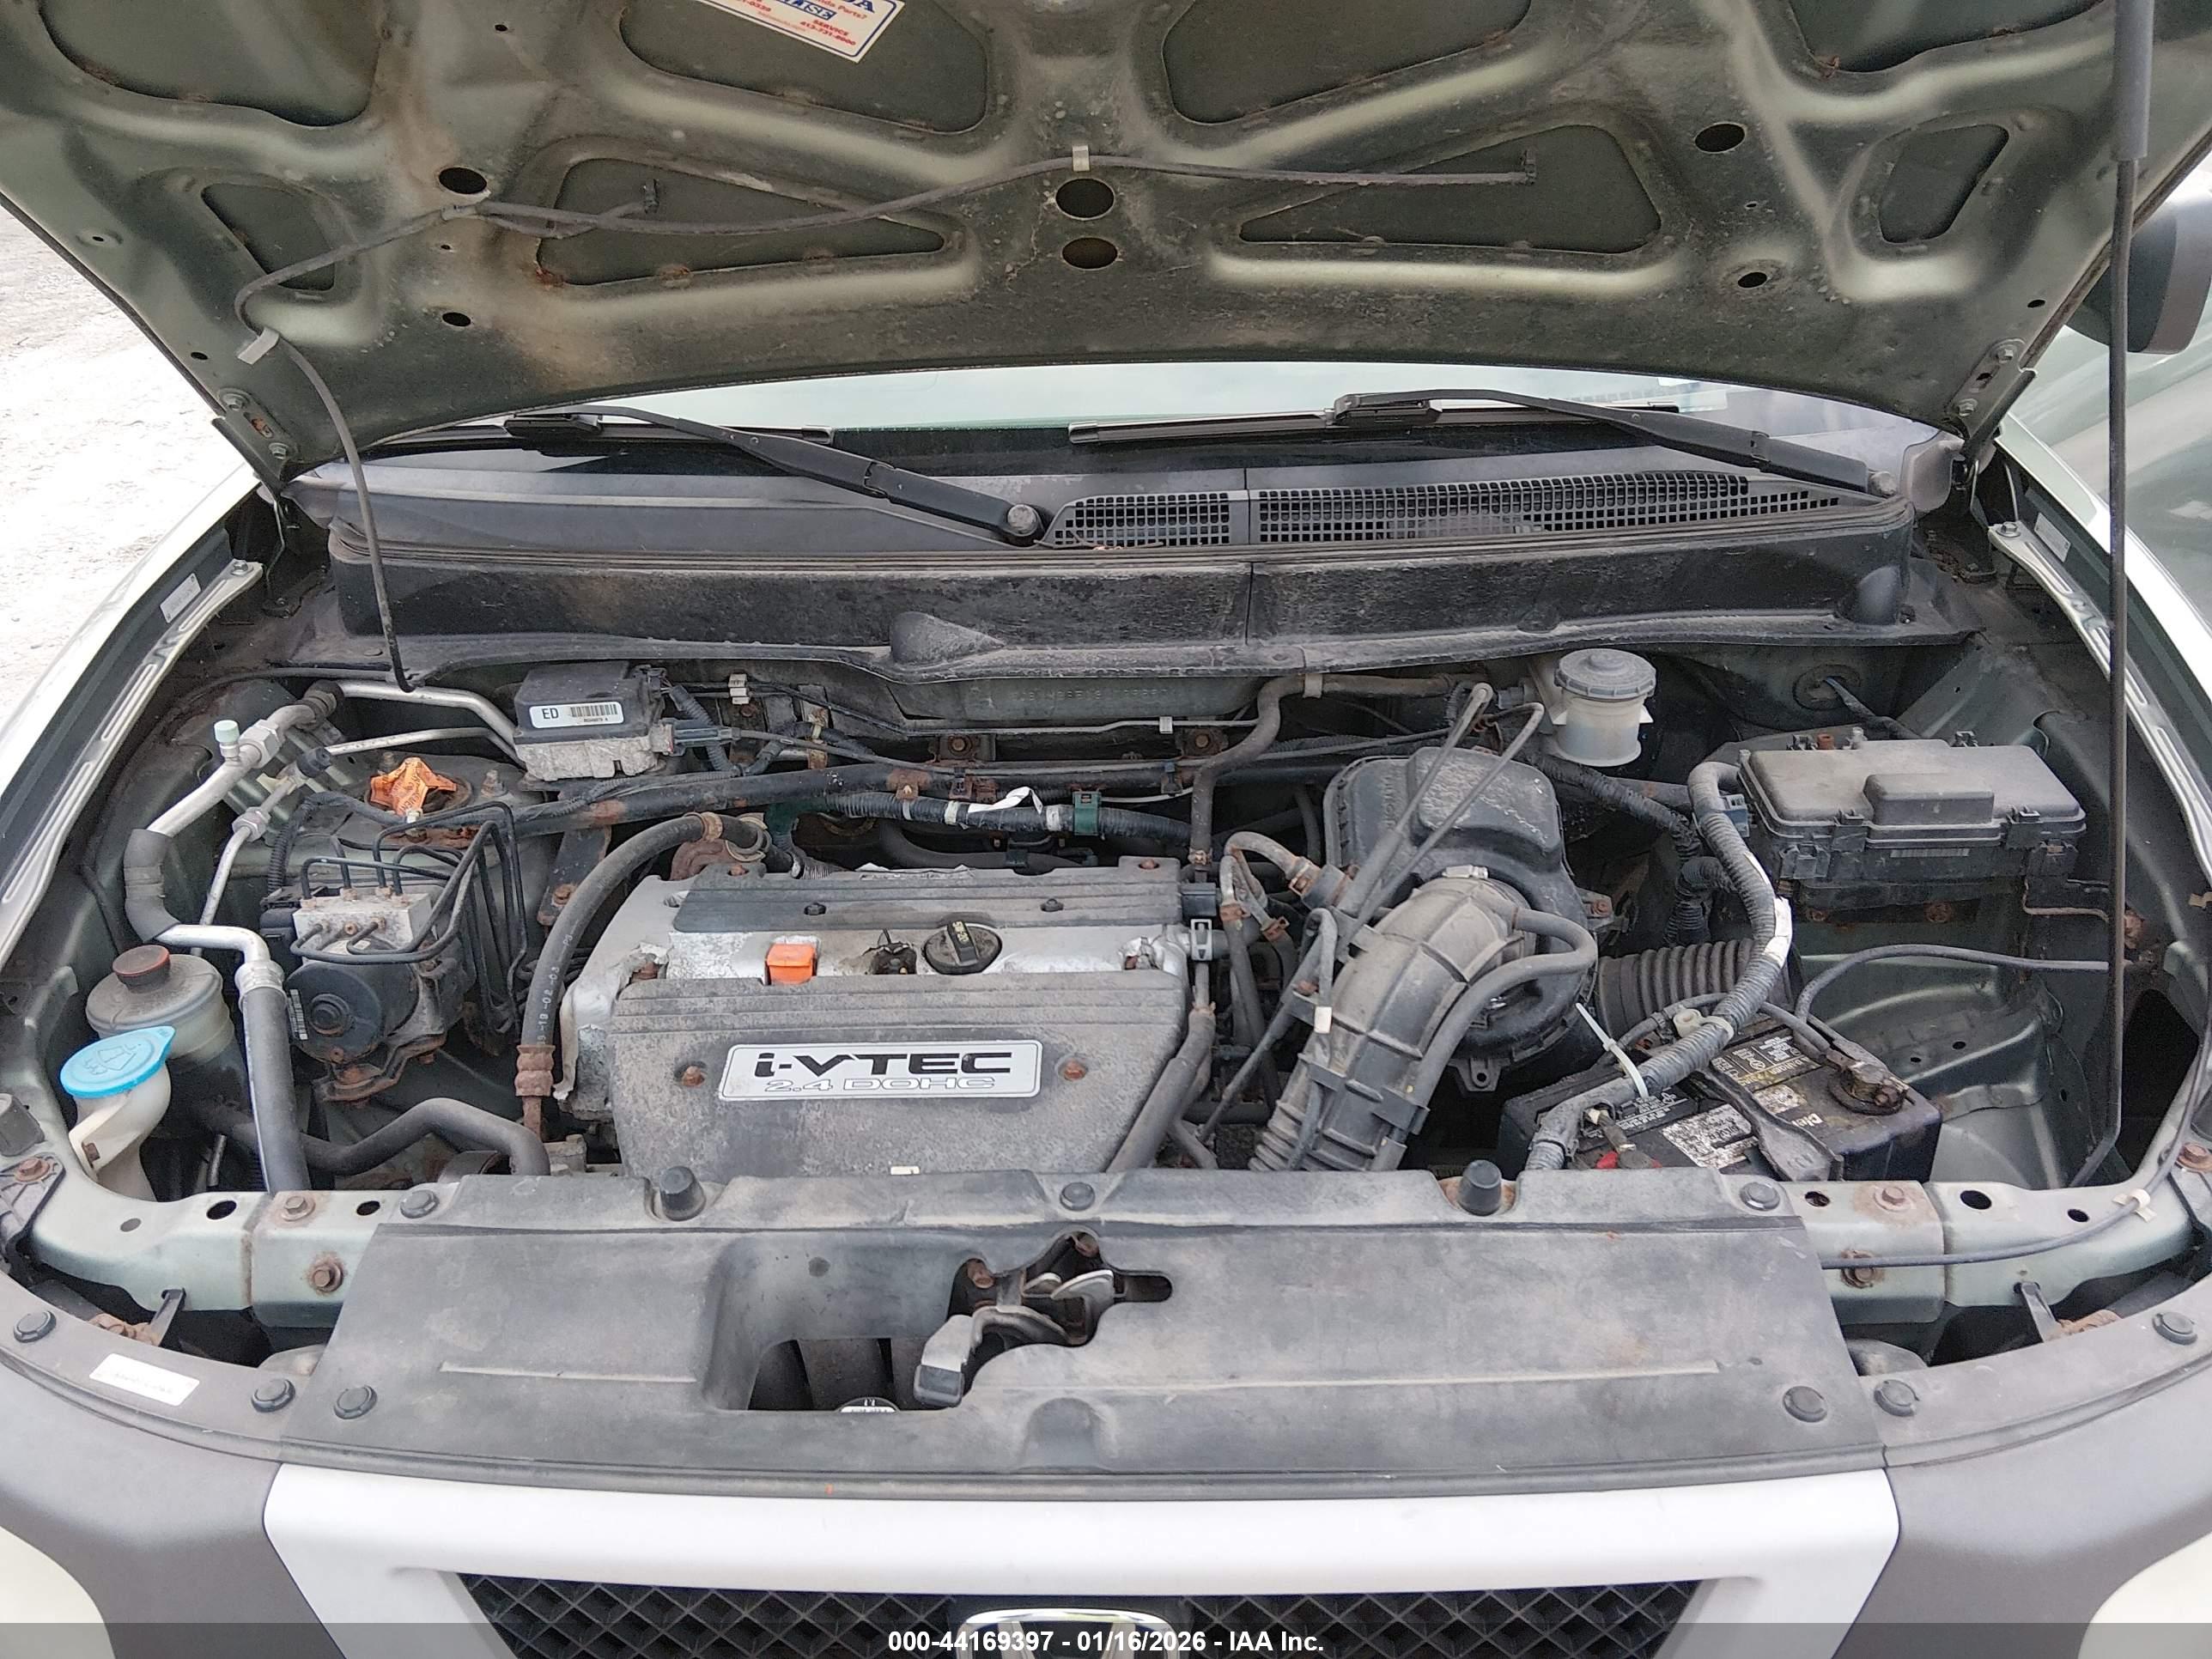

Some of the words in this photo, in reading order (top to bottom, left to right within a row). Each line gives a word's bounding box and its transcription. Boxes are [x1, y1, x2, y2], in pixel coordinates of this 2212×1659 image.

[837, 5, 868, 19] Parts?
[812, 19, 849, 36] SERVICE
[541, 707, 559, 720] ED
[754, 1052, 1012, 1077] i-VTEC
[764, 1078, 833, 1092] 2.4
[843, 1077, 995, 1091] DOHC
